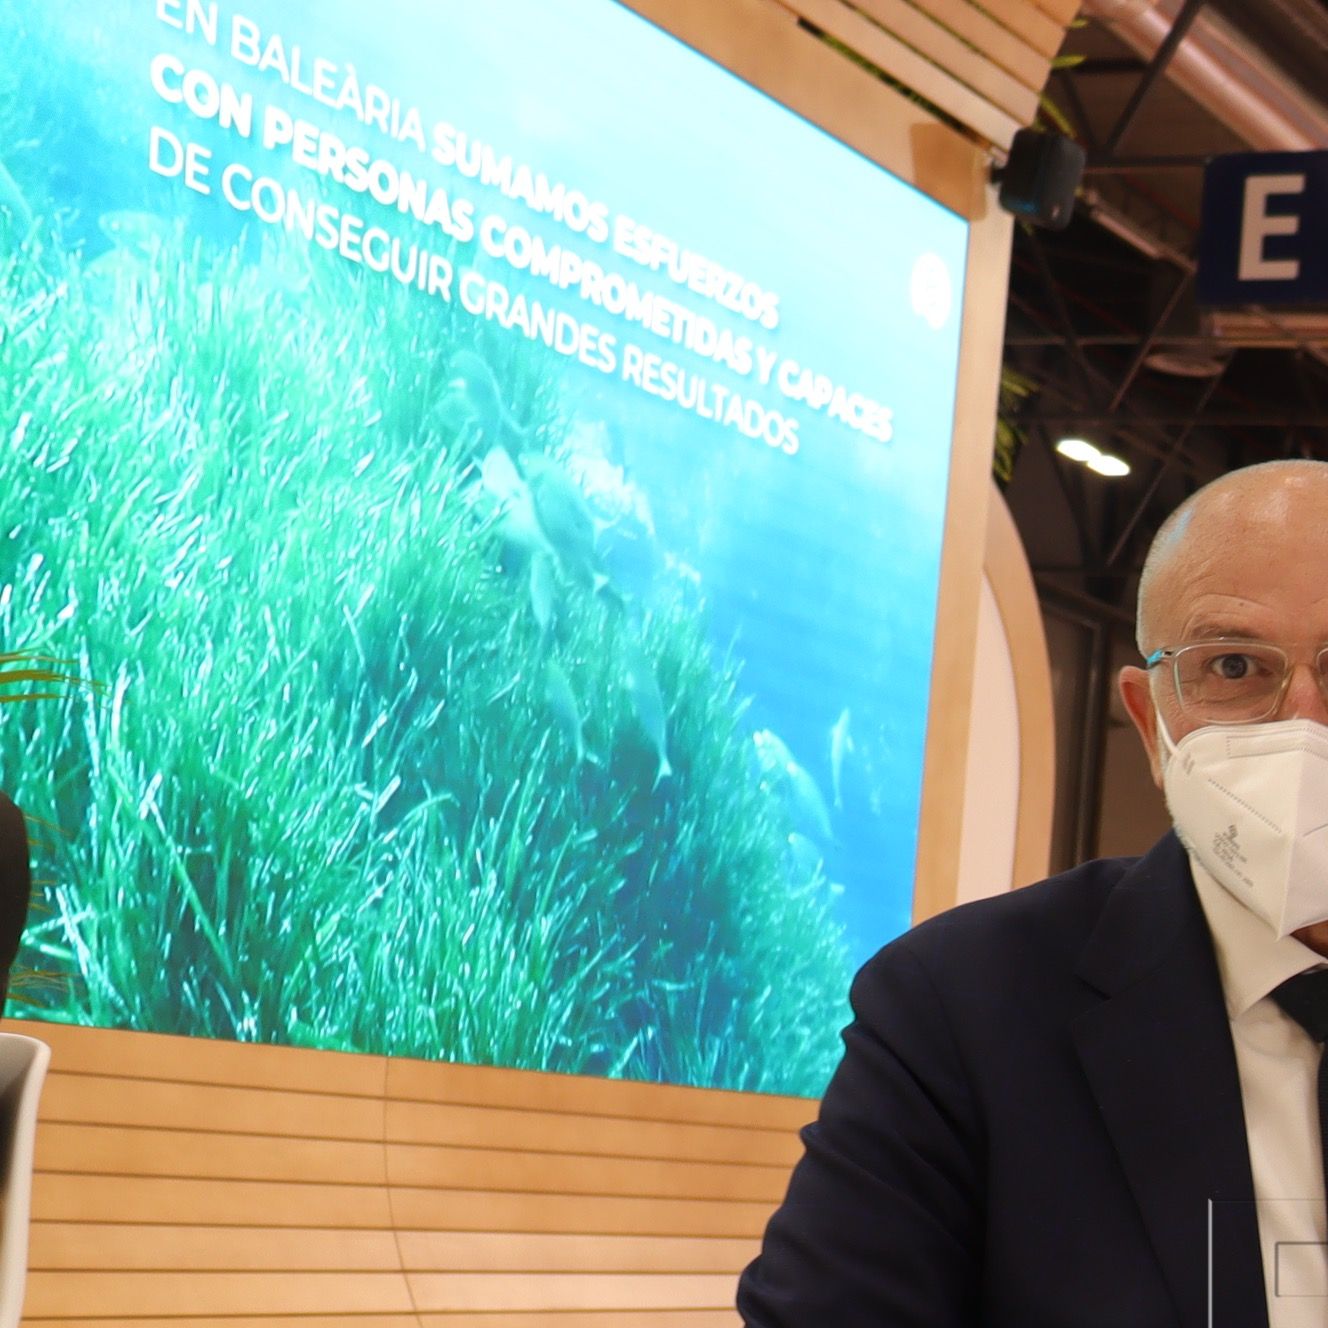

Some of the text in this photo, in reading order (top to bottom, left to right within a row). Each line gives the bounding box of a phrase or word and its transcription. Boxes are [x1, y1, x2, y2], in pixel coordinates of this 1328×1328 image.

[148, 125, 800, 456] DE CONSEGUIR GRANDES RESULTADOS
[150, 53, 894, 444] CON PERSONAS COMPROMETIDAS Y CAPACES
[156, 0, 781, 330] EN BALEÀRIA SUMAMOS ESFUERZOS
[1236, 172, 1307, 283] E
